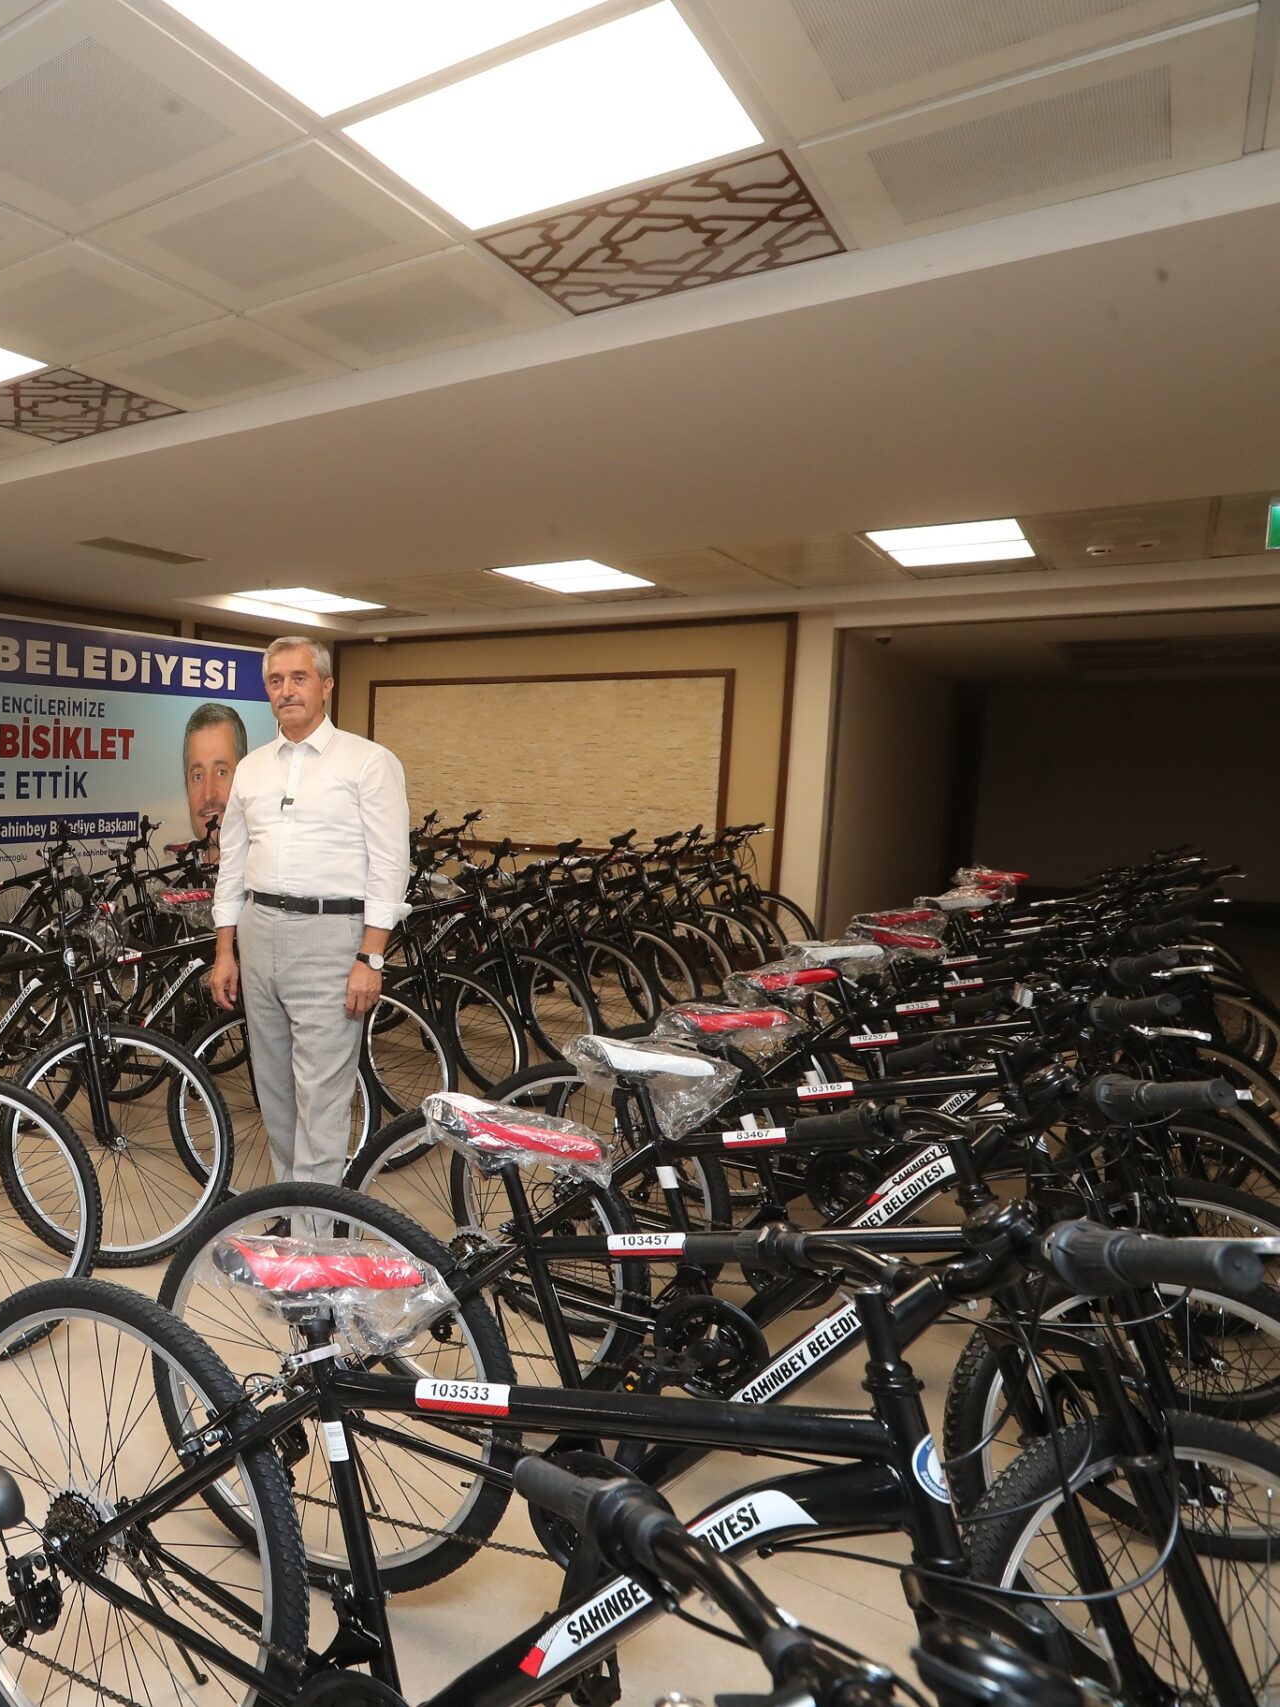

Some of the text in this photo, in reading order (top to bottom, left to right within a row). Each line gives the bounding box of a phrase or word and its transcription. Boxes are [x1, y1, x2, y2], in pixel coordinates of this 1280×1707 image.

[15, 765, 88, 800] ETTİK
[98, 817, 137, 835] Başkanı
[807, 1084, 842, 1093] 103165
[736, 1130, 770, 1140] 83467
[620, 1234, 670, 1246] 103457
[431, 1383, 489, 1401] 103533
